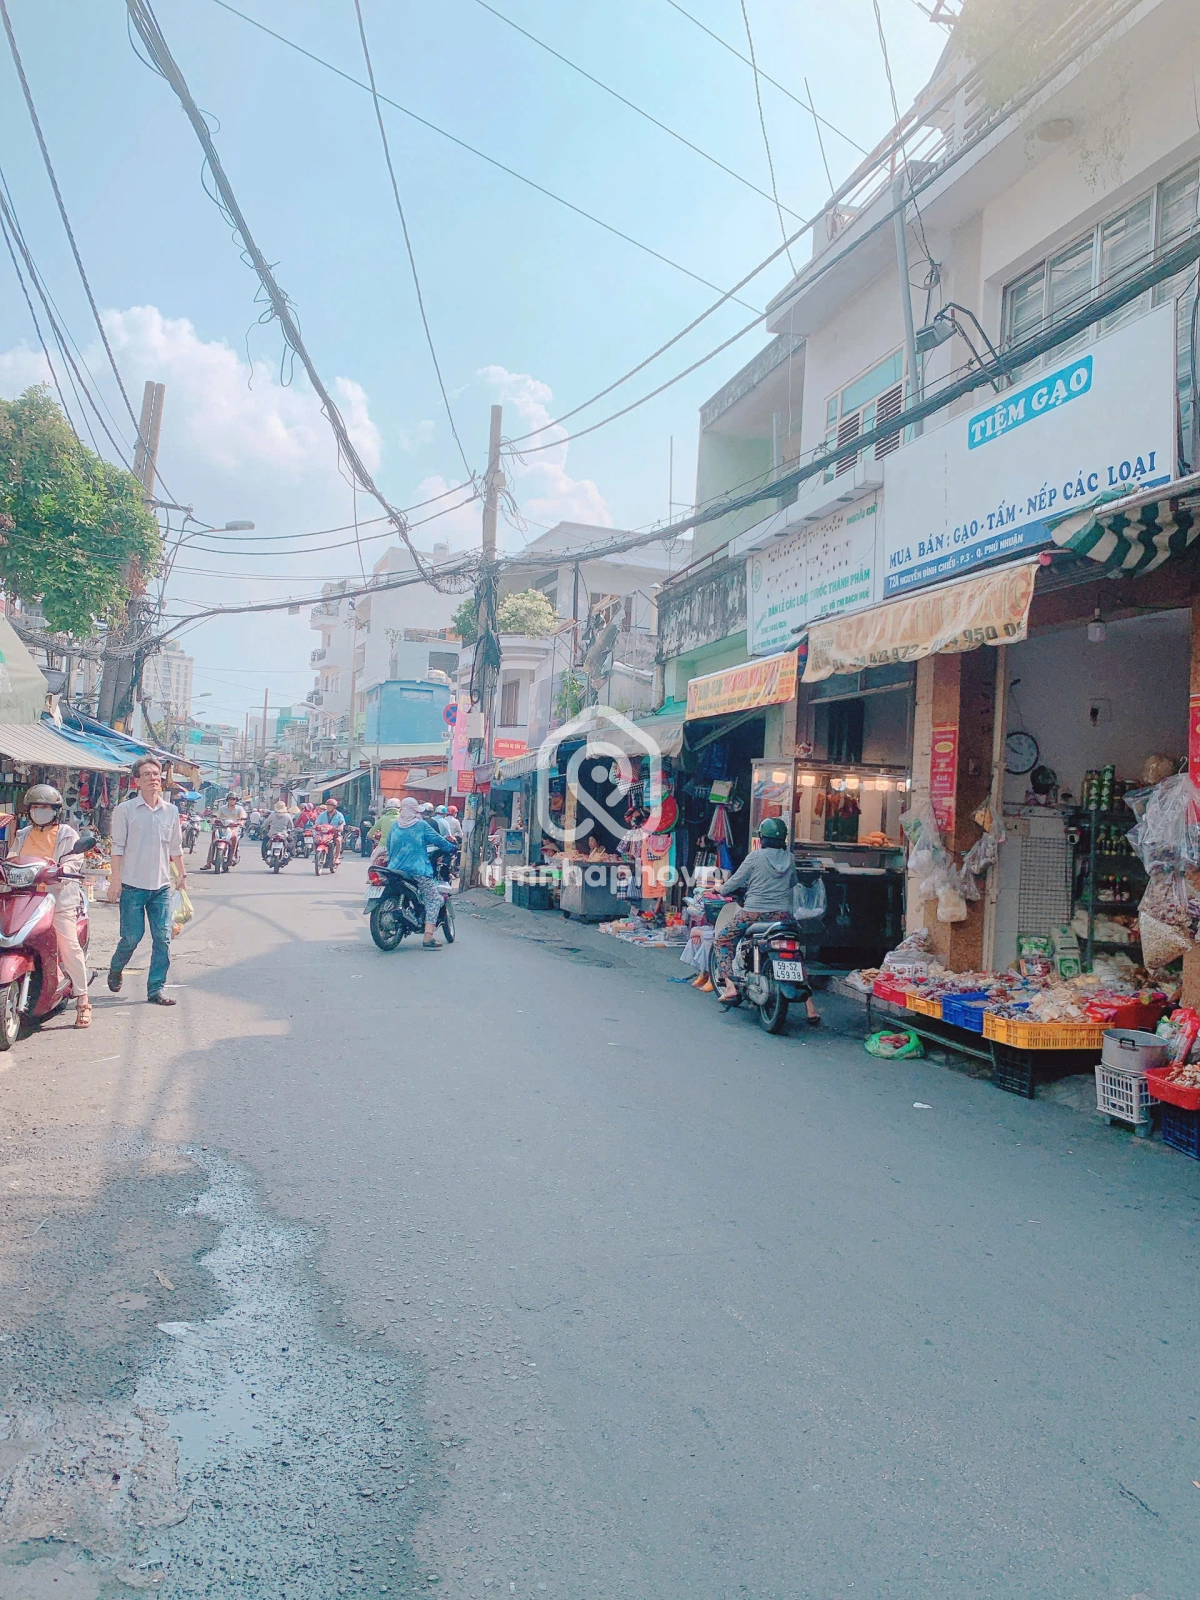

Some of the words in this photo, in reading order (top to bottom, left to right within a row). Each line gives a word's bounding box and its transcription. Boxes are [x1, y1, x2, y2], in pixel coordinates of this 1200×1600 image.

[971, 398, 1026, 443] TIỆM
[1031, 367, 1089, 411] GẠO
[889, 547, 912, 569] MUA
[1063, 470, 1099, 500] CÁC
[1107, 451, 1156, 486] LOẠI
[888, 574, 899, 589] 72A
[900, 568, 922, 585] NGUYỄN
[922, 564, 938, 578] ĐÌNH
[938, 556, 956, 573] CHIỂU
[984, 540, 999, 555] PHÚ
[999, 533, 1024, 551] NHUẬN
[963, 626, 999, 643] 950
[777, 961, 798, 971] 59-S2
